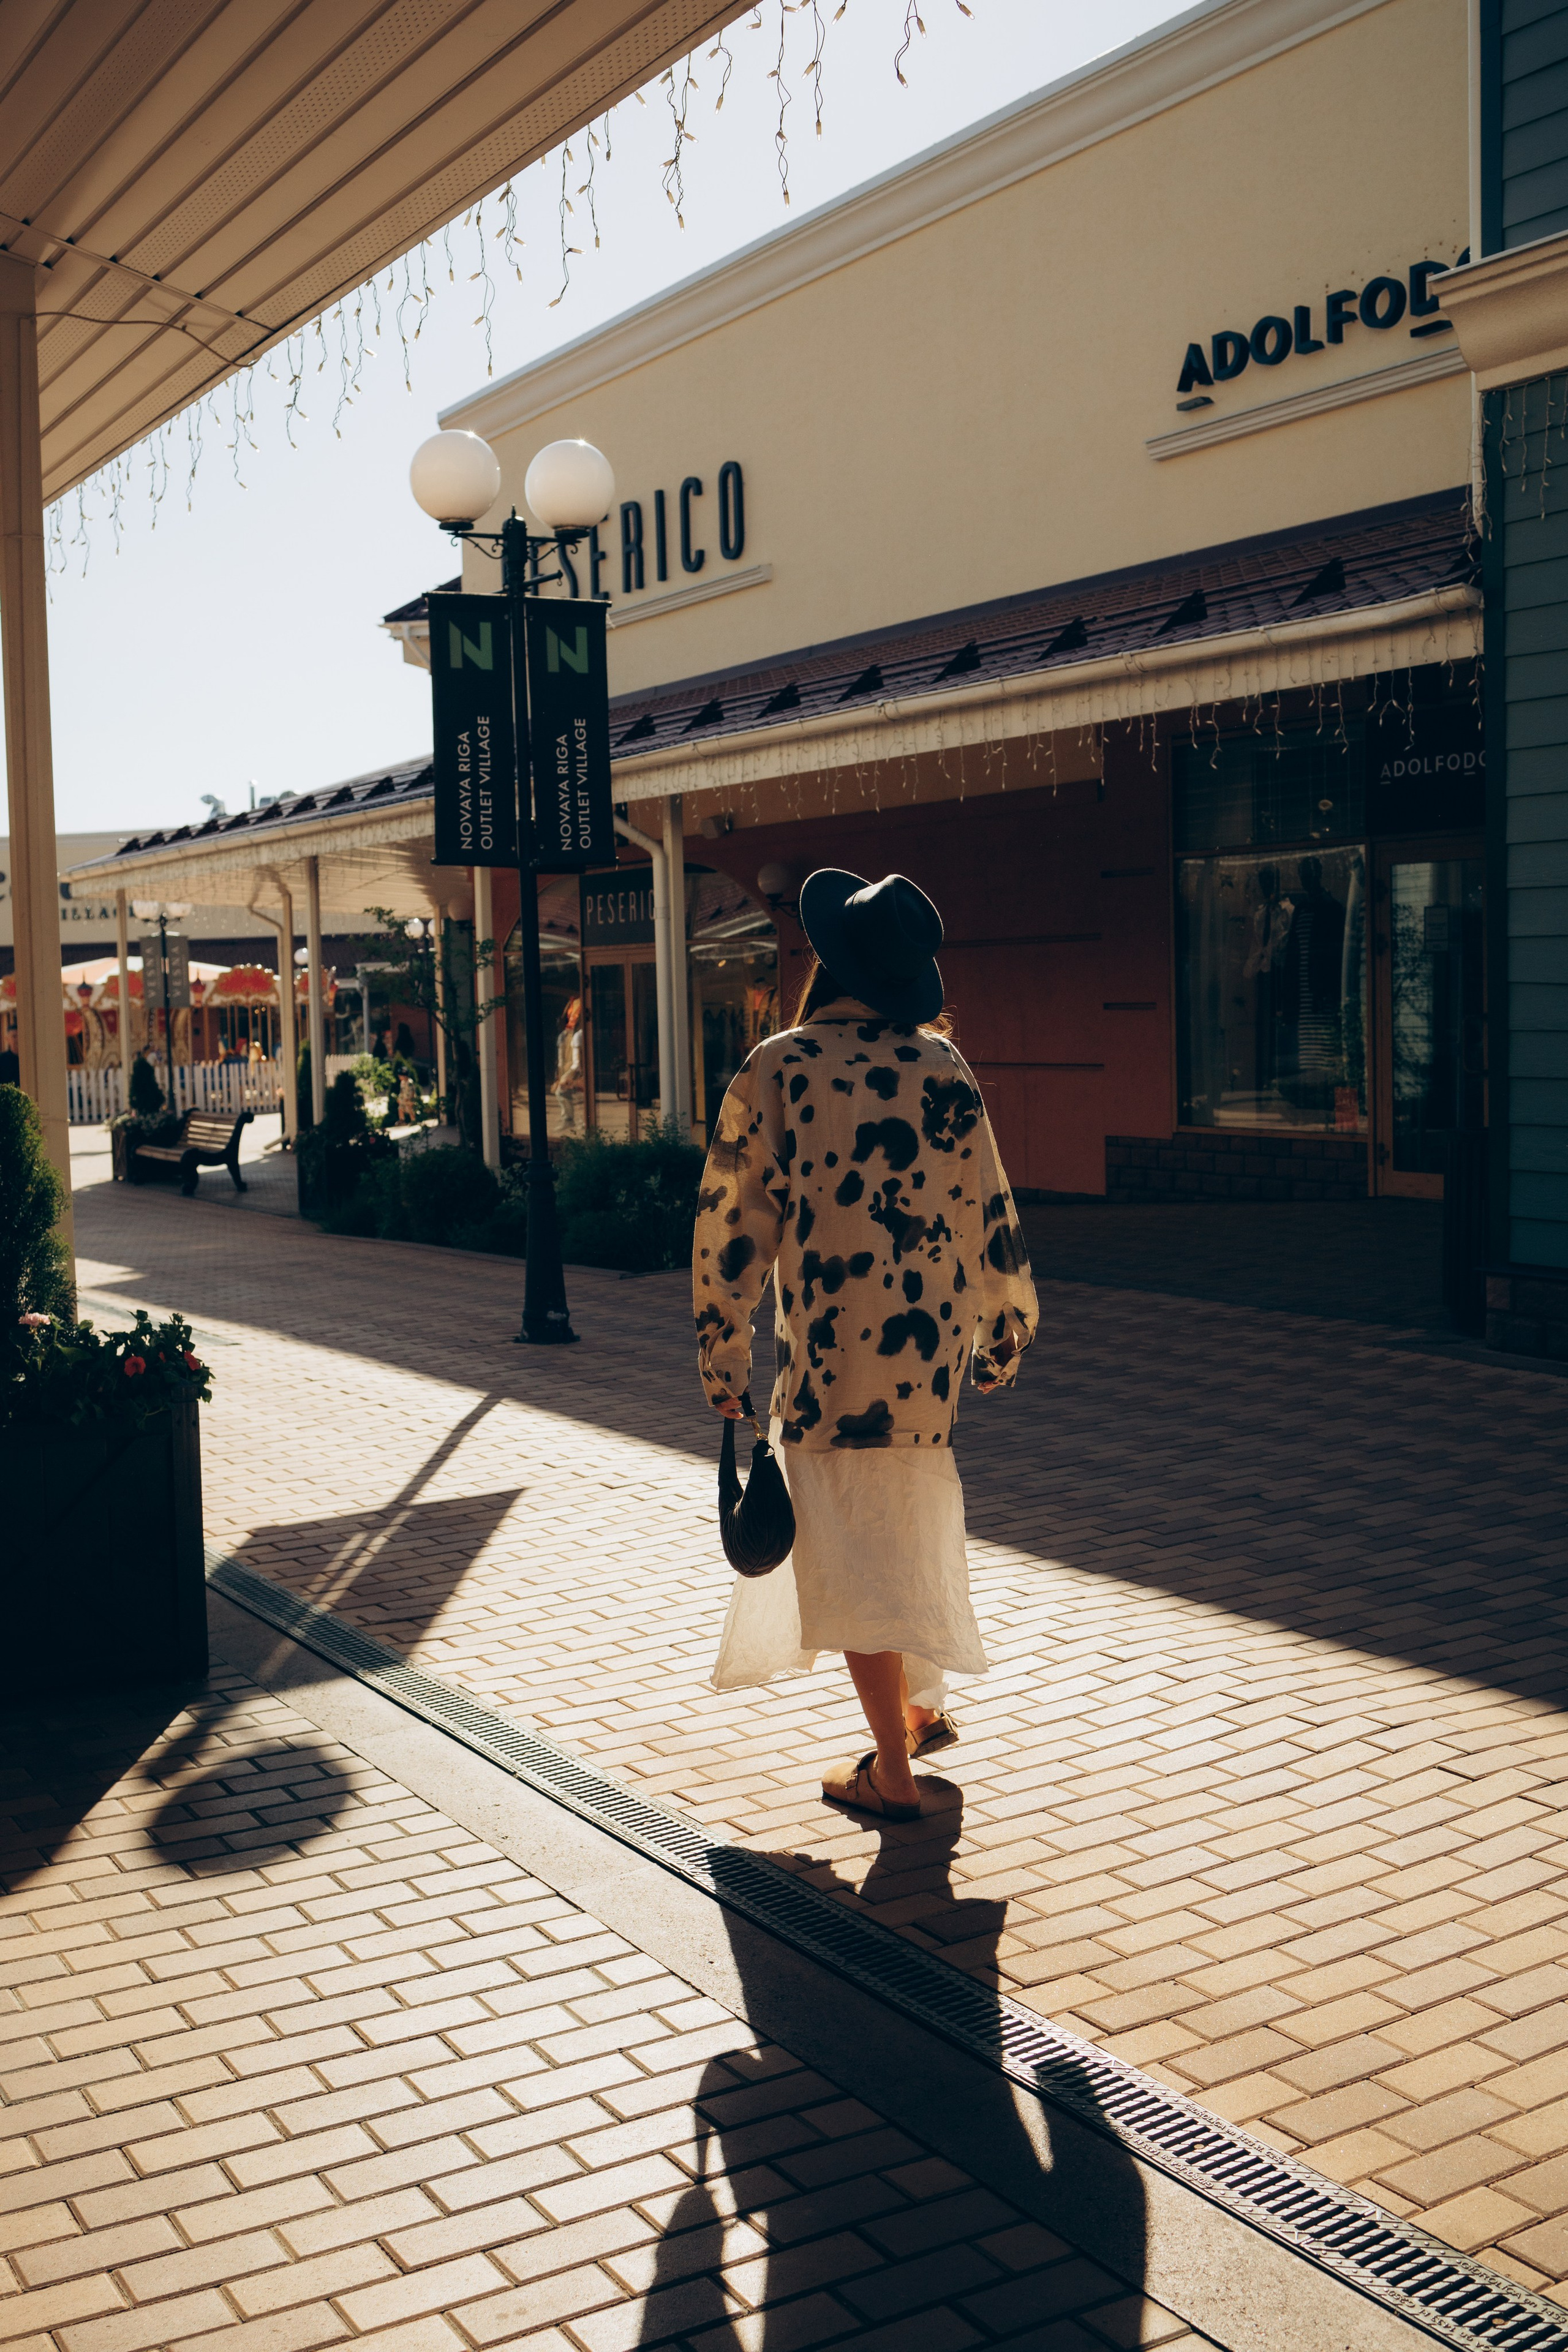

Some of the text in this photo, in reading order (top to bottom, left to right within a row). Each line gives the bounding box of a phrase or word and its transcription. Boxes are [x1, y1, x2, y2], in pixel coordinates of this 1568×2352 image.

[1177, 246, 1471, 393] ADOLFOD
[458, 731, 473, 850] NOVAYA RIGA
[477, 716, 493, 850] OUTLET VILLAGE
[556, 734, 572, 851] NOVAYA RIGA
[575, 718, 591, 849] OUTLET VILLAGE
[1114, 2126, 1133, 2139] C250
[1142, 2144, 1160, 2155] 1433
[1185, 2104, 1226, 2131] GIDROLICA
[1237, 2133, 1255, 2147] 1433
[1265, 2151, 1286, 2165] C250
[1170, 2162, 1213, 2188] GIDROLICA
[1386, 2290, 1415, 2307] C250
[1461, 2262, 1522, 2299] GIDROLICA
[1431, 2315, 1457, 2332] 1433
